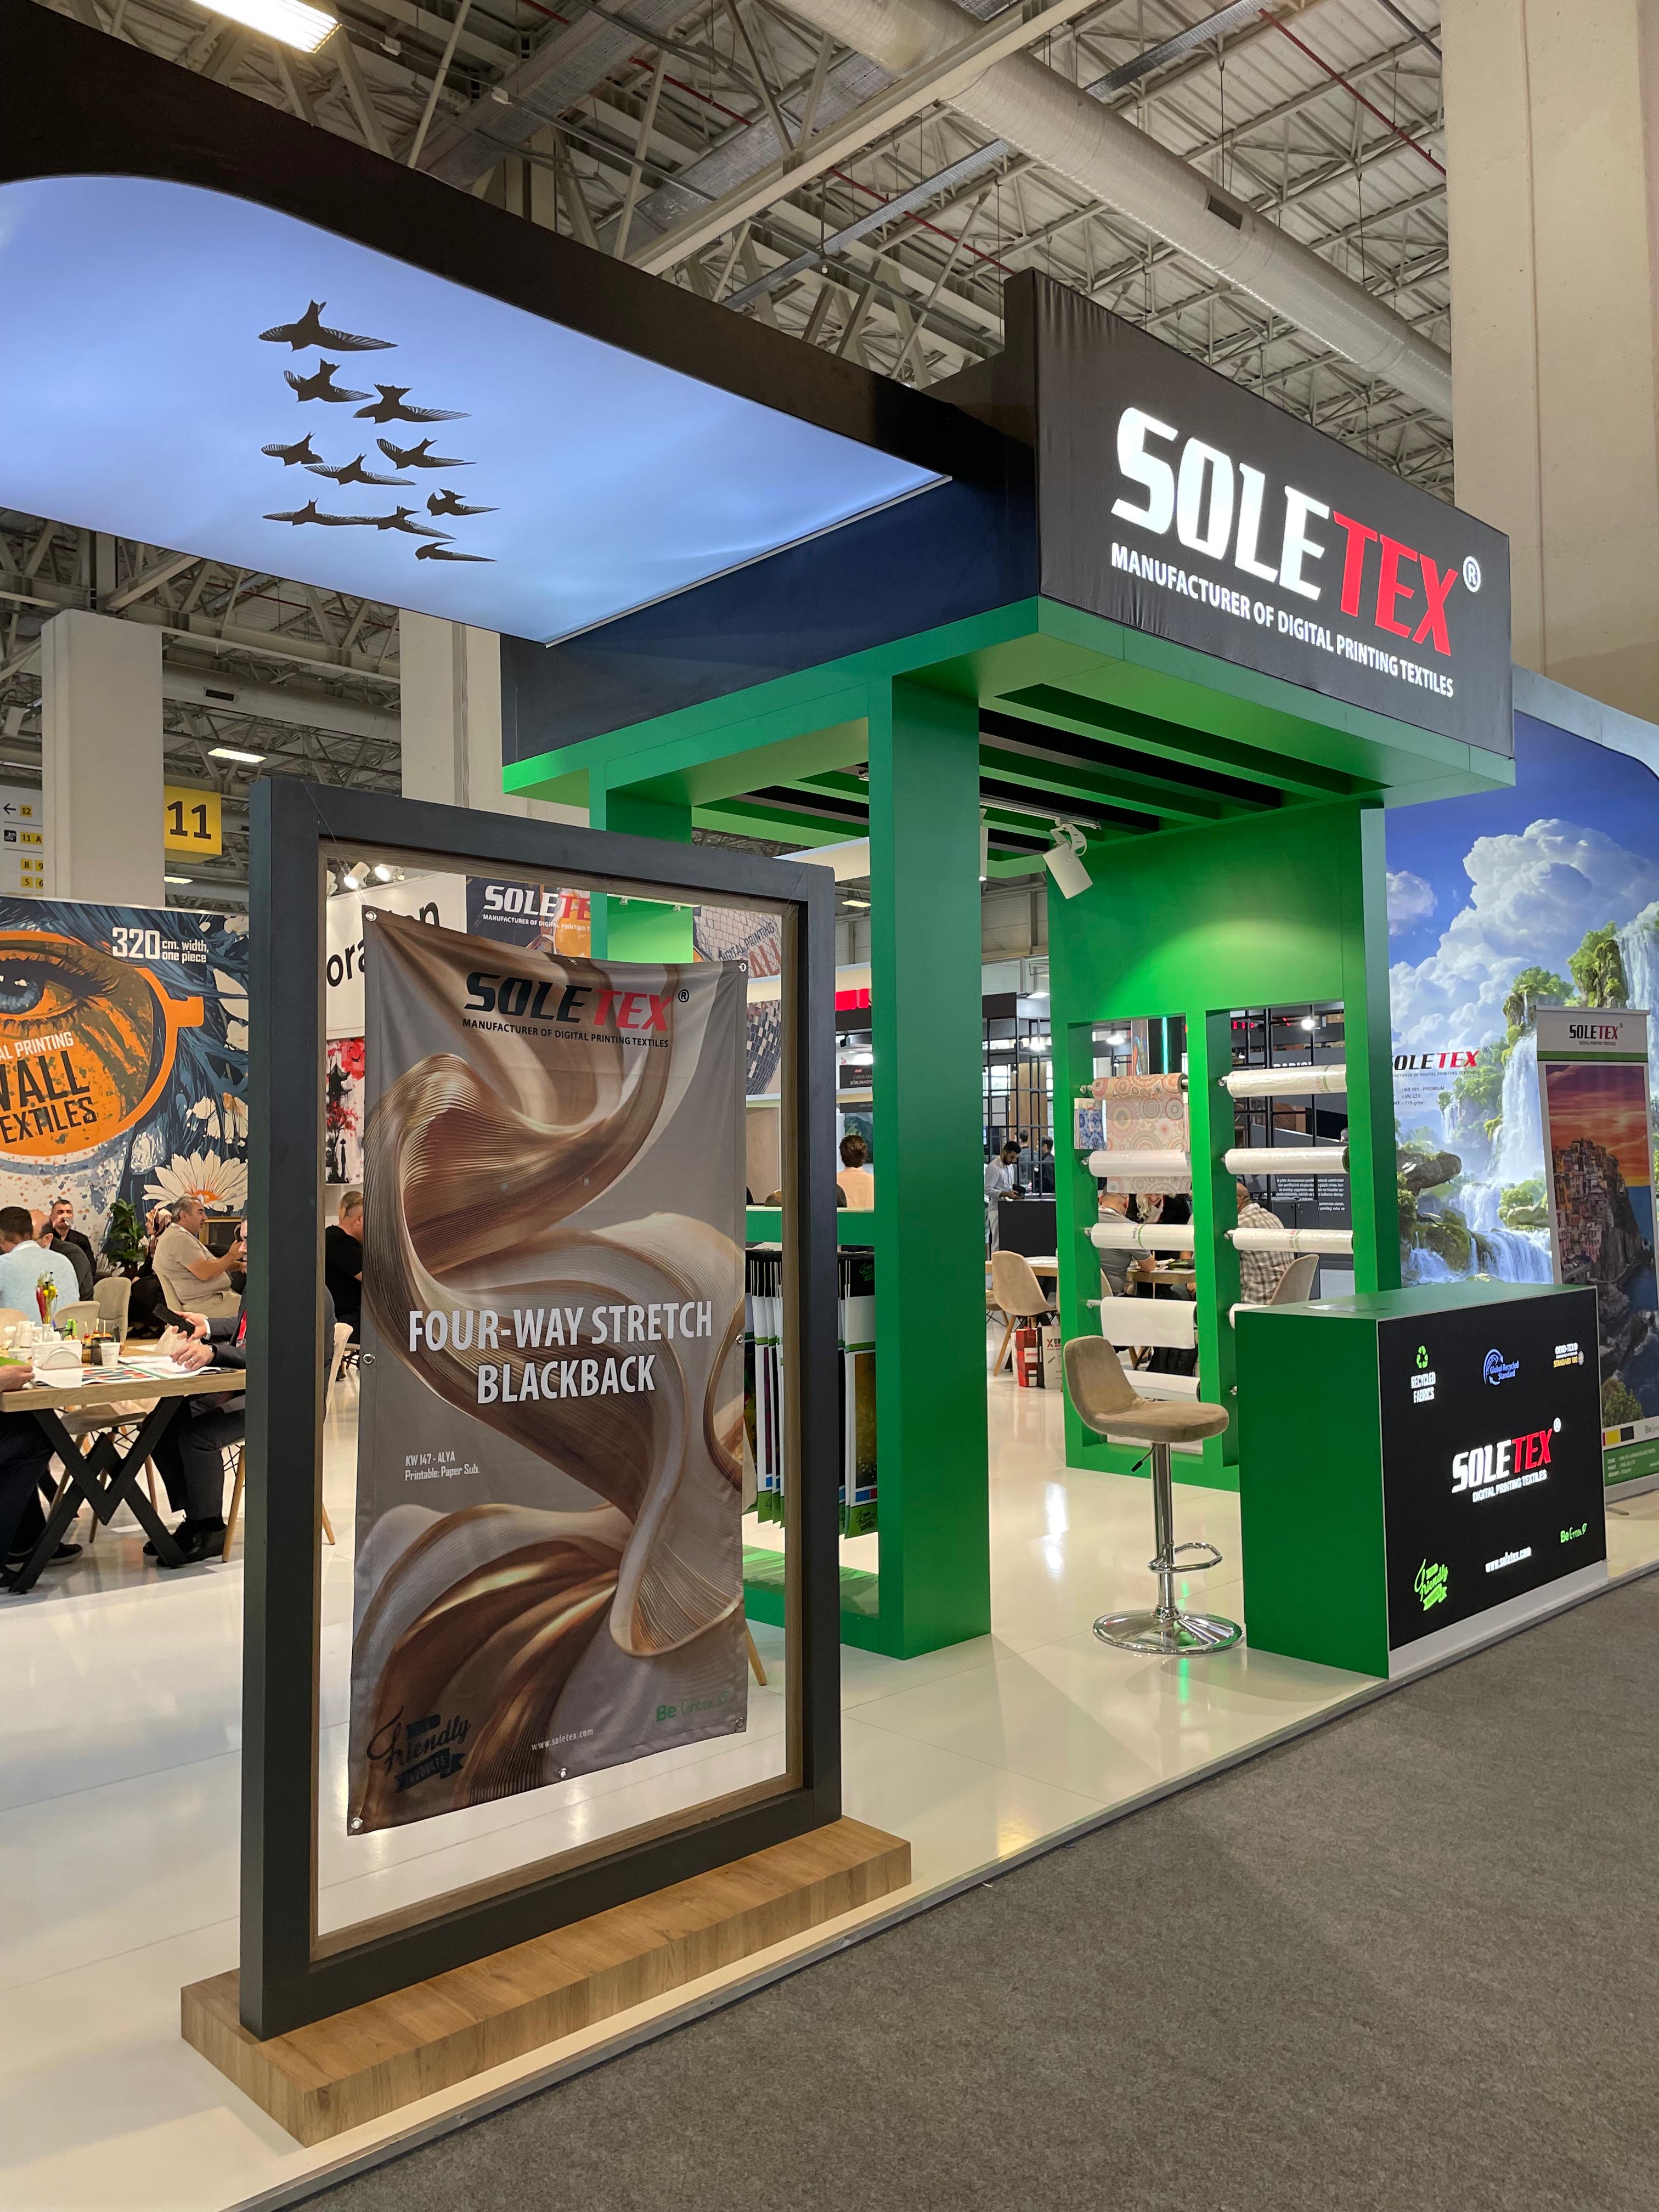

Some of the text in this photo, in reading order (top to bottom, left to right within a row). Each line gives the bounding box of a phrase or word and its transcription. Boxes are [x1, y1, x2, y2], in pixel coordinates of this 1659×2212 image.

[1111, 542, 1453, 697] MANUFACTURER OF DIGITAL PRINTING TEXTILES
[167, 801, 211, 840] 11
[483, 914, 529, 925] MANUFACTURER
[112, 927, 209, 960] 320 cm. width,
[719, 922, 775, 961] DIGITAL PRINTING
[162, 951, 207, 964] one piece
[462, 1018, 669, 1048] MANUFACTURER OF DIGITAL PRINTING TEXTILES
[14, 1031, 74, 1057] PRINTING
[409, 1301, 712, 1352] FOUR-WAY STRETCH
[1489, 1361, 1519, 1374] Global Recycled
[1498, 1369, 1515, 1380] Standard
[477, 1355, 656, 1404] BLACKBACK
[1411, 1372, 1436, 1389] RECYCLED
[1413, 1386, 1435, 1403] FABRICS
[405, 1455, 419, 1466] KW
[420, 1453, 431, 1465] 147
[438, 1451, 455, 1463] ALYA
[405, 1463, 480, 1481] Printable: Paper Sub.
[1472, 1469, 1547, 1503] DIGITAL PRINTING TEXTILES
[1560, 1530, 1569, 1543] Be
[656, 1703, 676, 1722] Be
[531, 1728, 594, 1751] www.soletex.com
